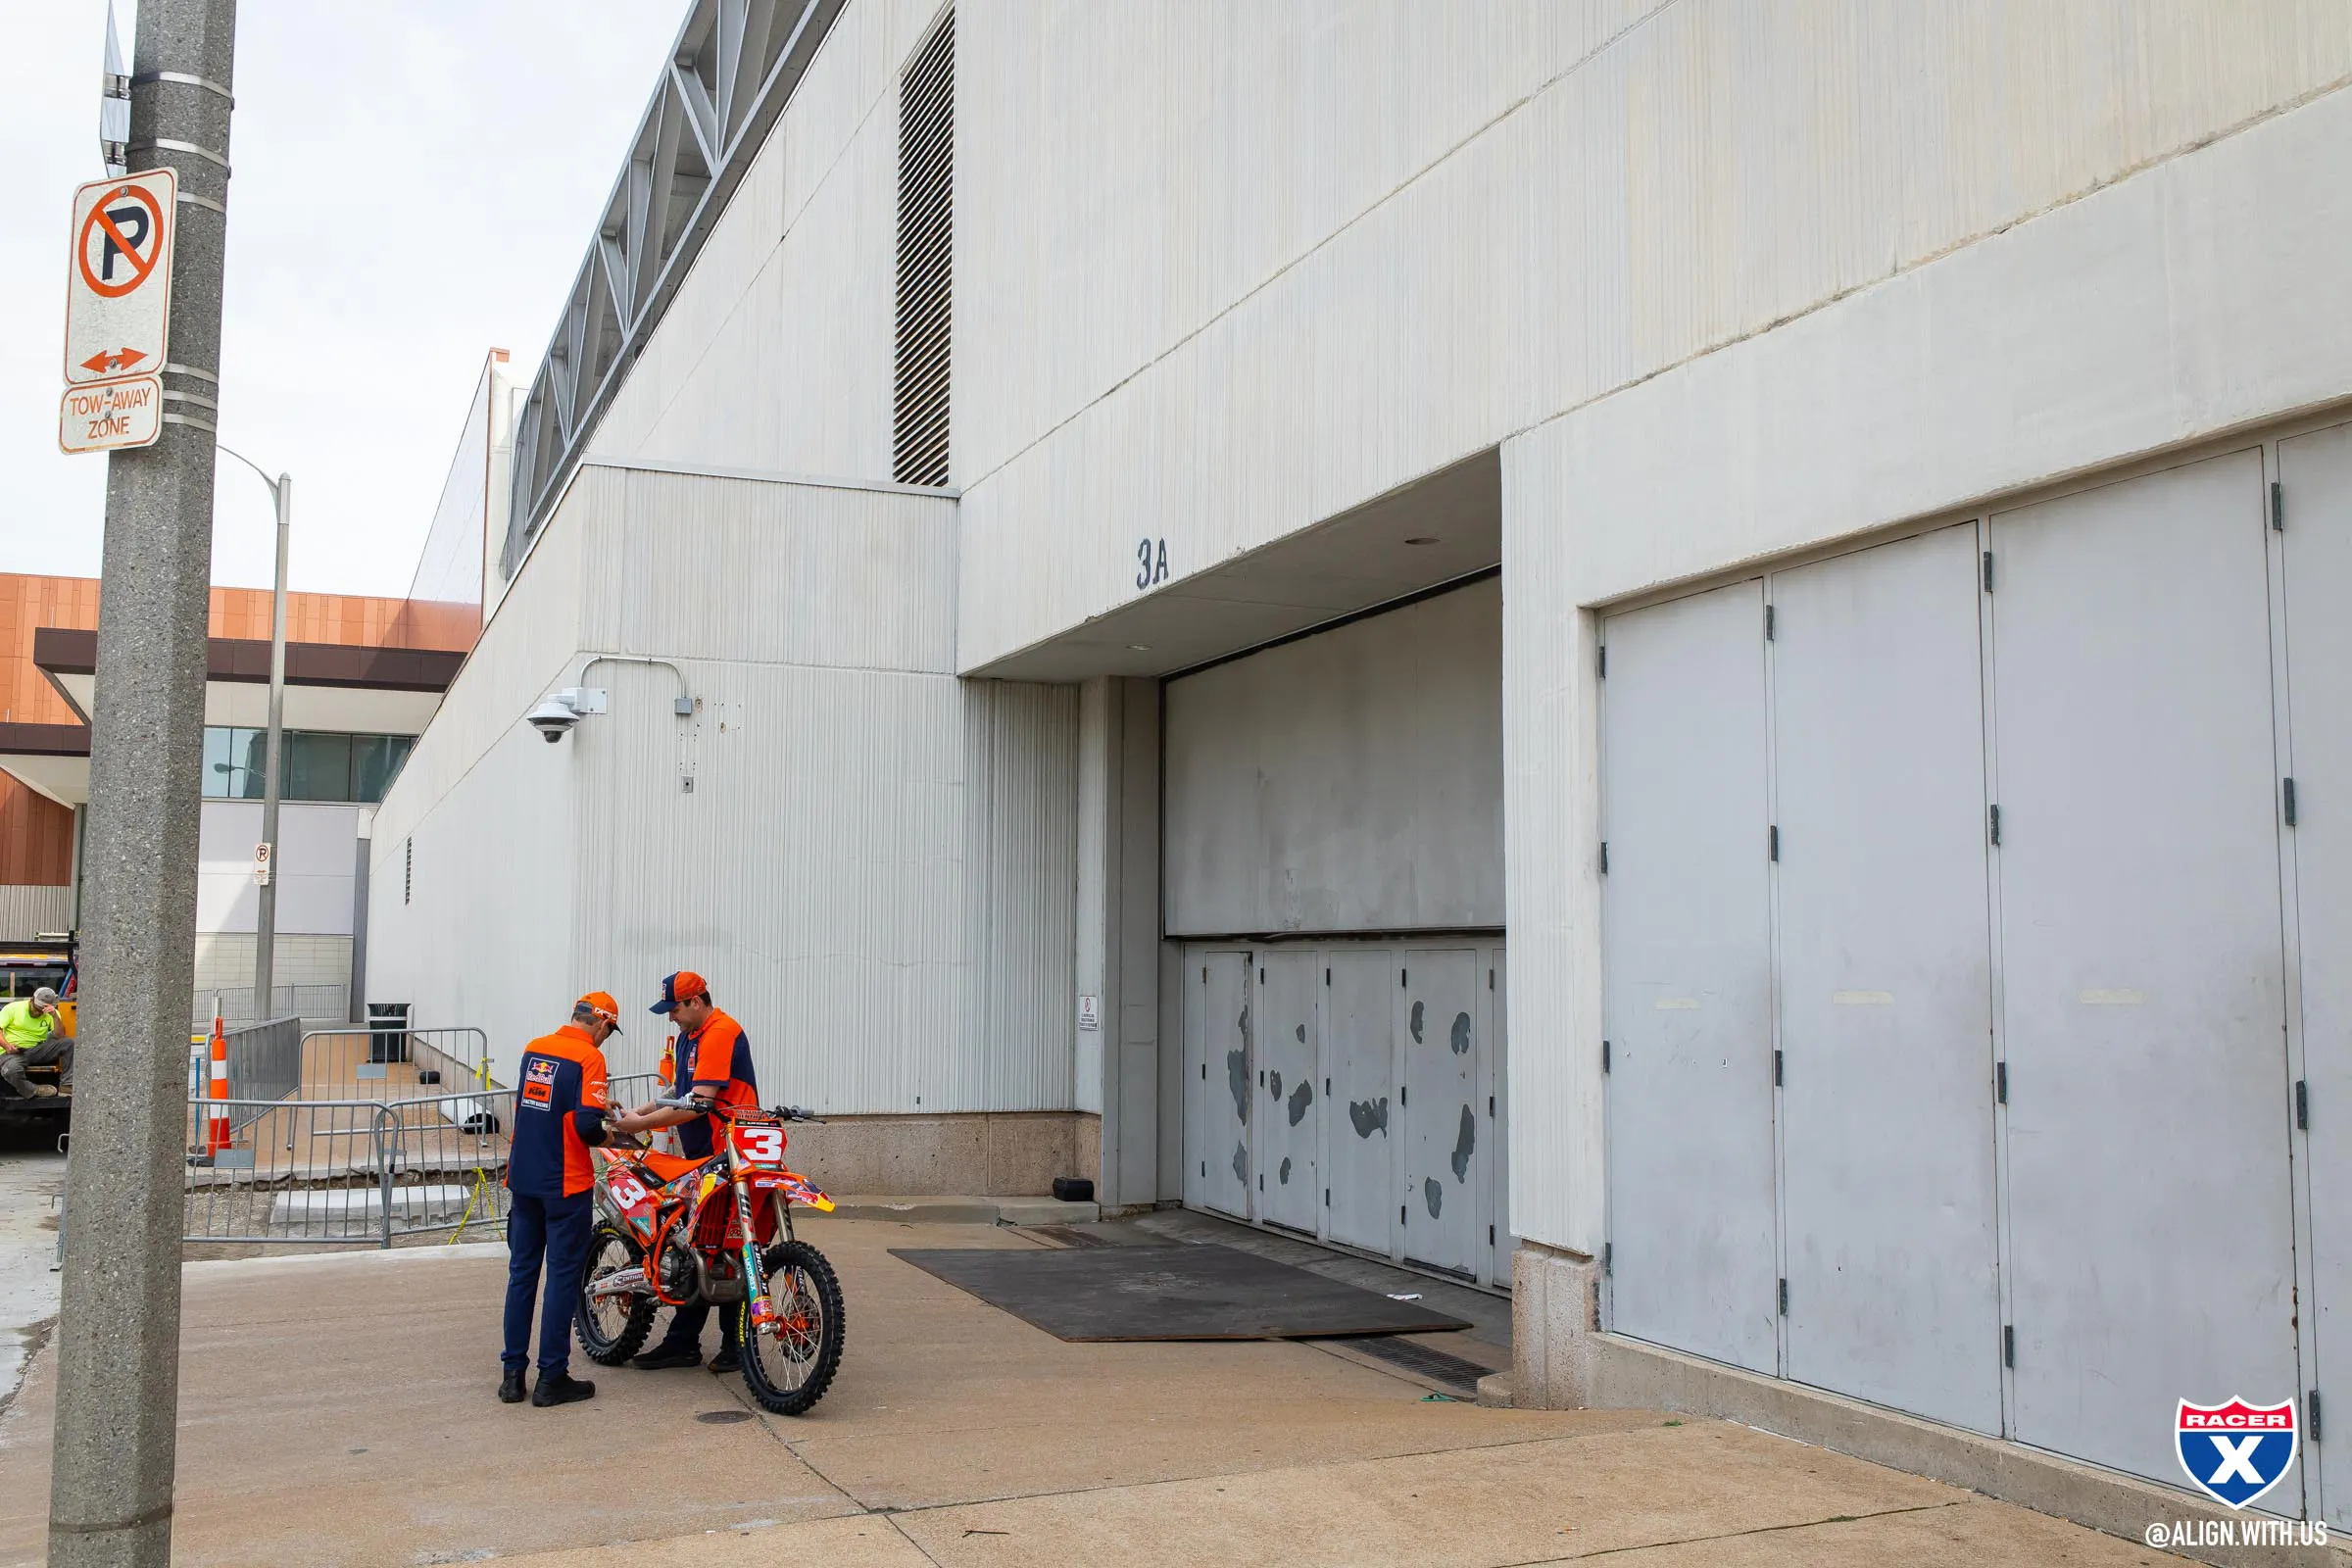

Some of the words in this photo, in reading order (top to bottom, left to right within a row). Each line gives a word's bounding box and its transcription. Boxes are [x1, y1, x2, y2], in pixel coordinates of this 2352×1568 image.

[70, 388, 151, 416] TOW-AWAY
[87, 416, 130, 439] ZONE
[1137, 538, 1169, 590] 3A
[528, 1087, 546, 1097] KTM
[743, 1129, 782, 1160] 3
[612, 1178, 647, 1209] 3
[744, 1257, 758, 1292] MOTOREX
[755, 1252, 768, 1294] DUNP
